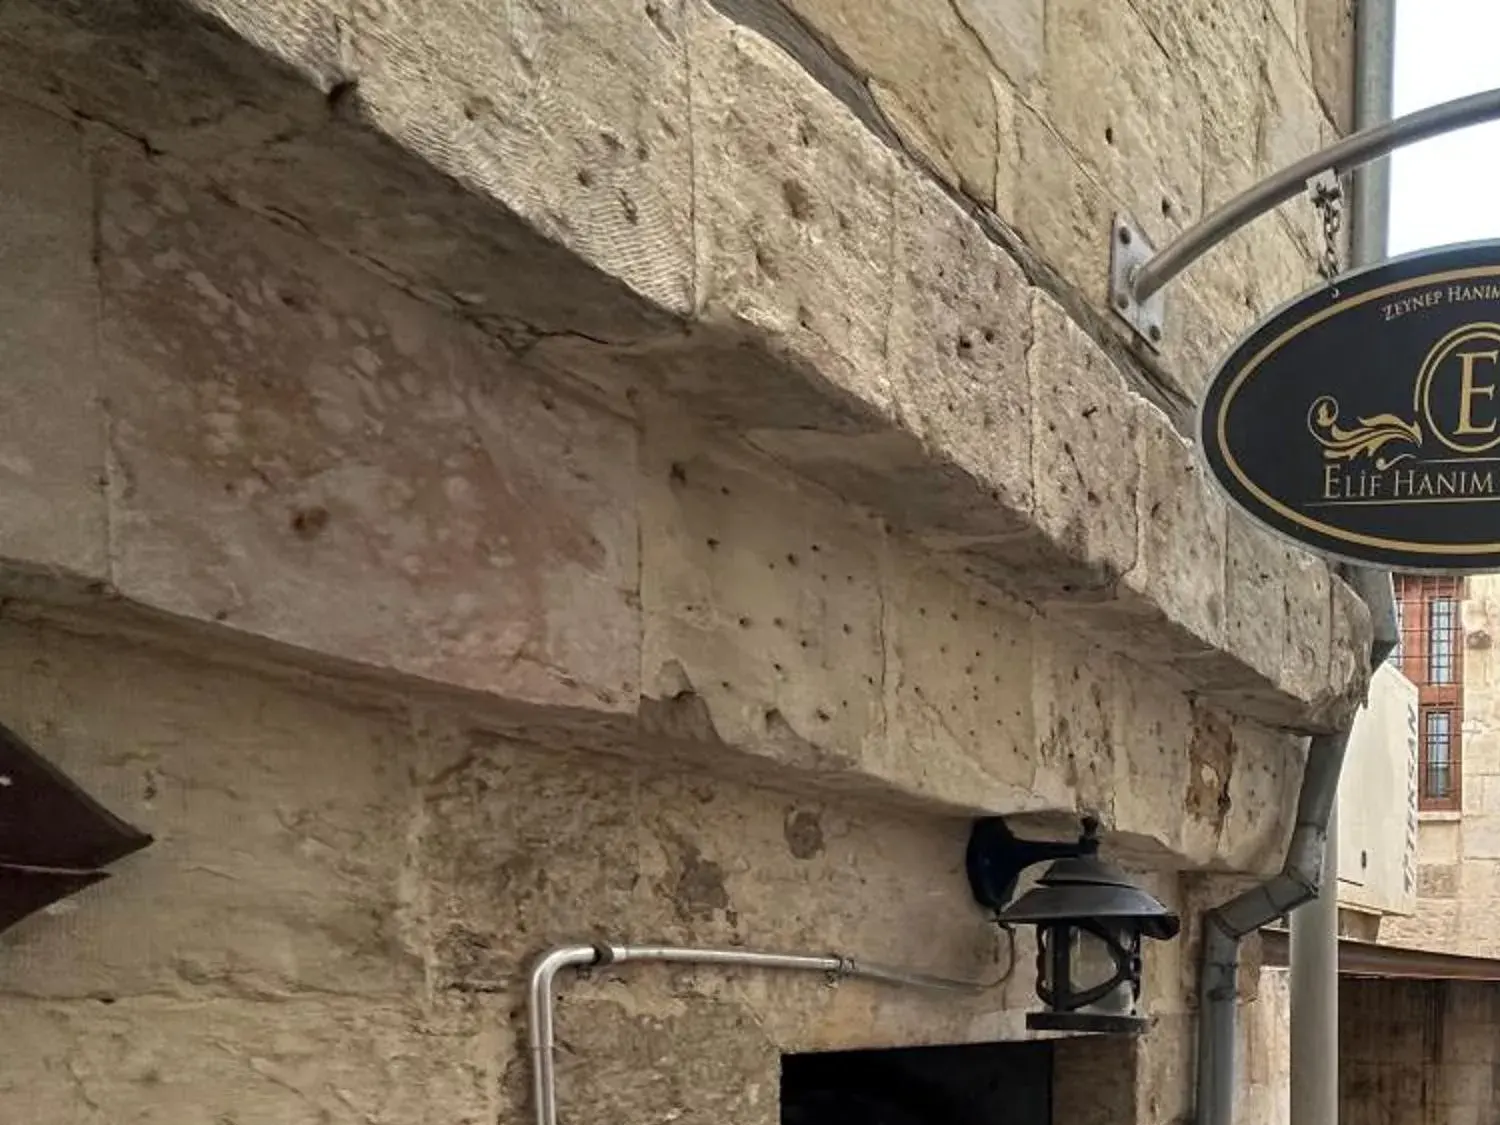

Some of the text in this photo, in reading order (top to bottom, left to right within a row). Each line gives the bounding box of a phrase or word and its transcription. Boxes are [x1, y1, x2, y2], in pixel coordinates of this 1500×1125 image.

[1382, 291, 1443, 321] ZEYNEP
[1453, 350, 1500, 436] E
[1394, 468, 1494, 497] HANIM
